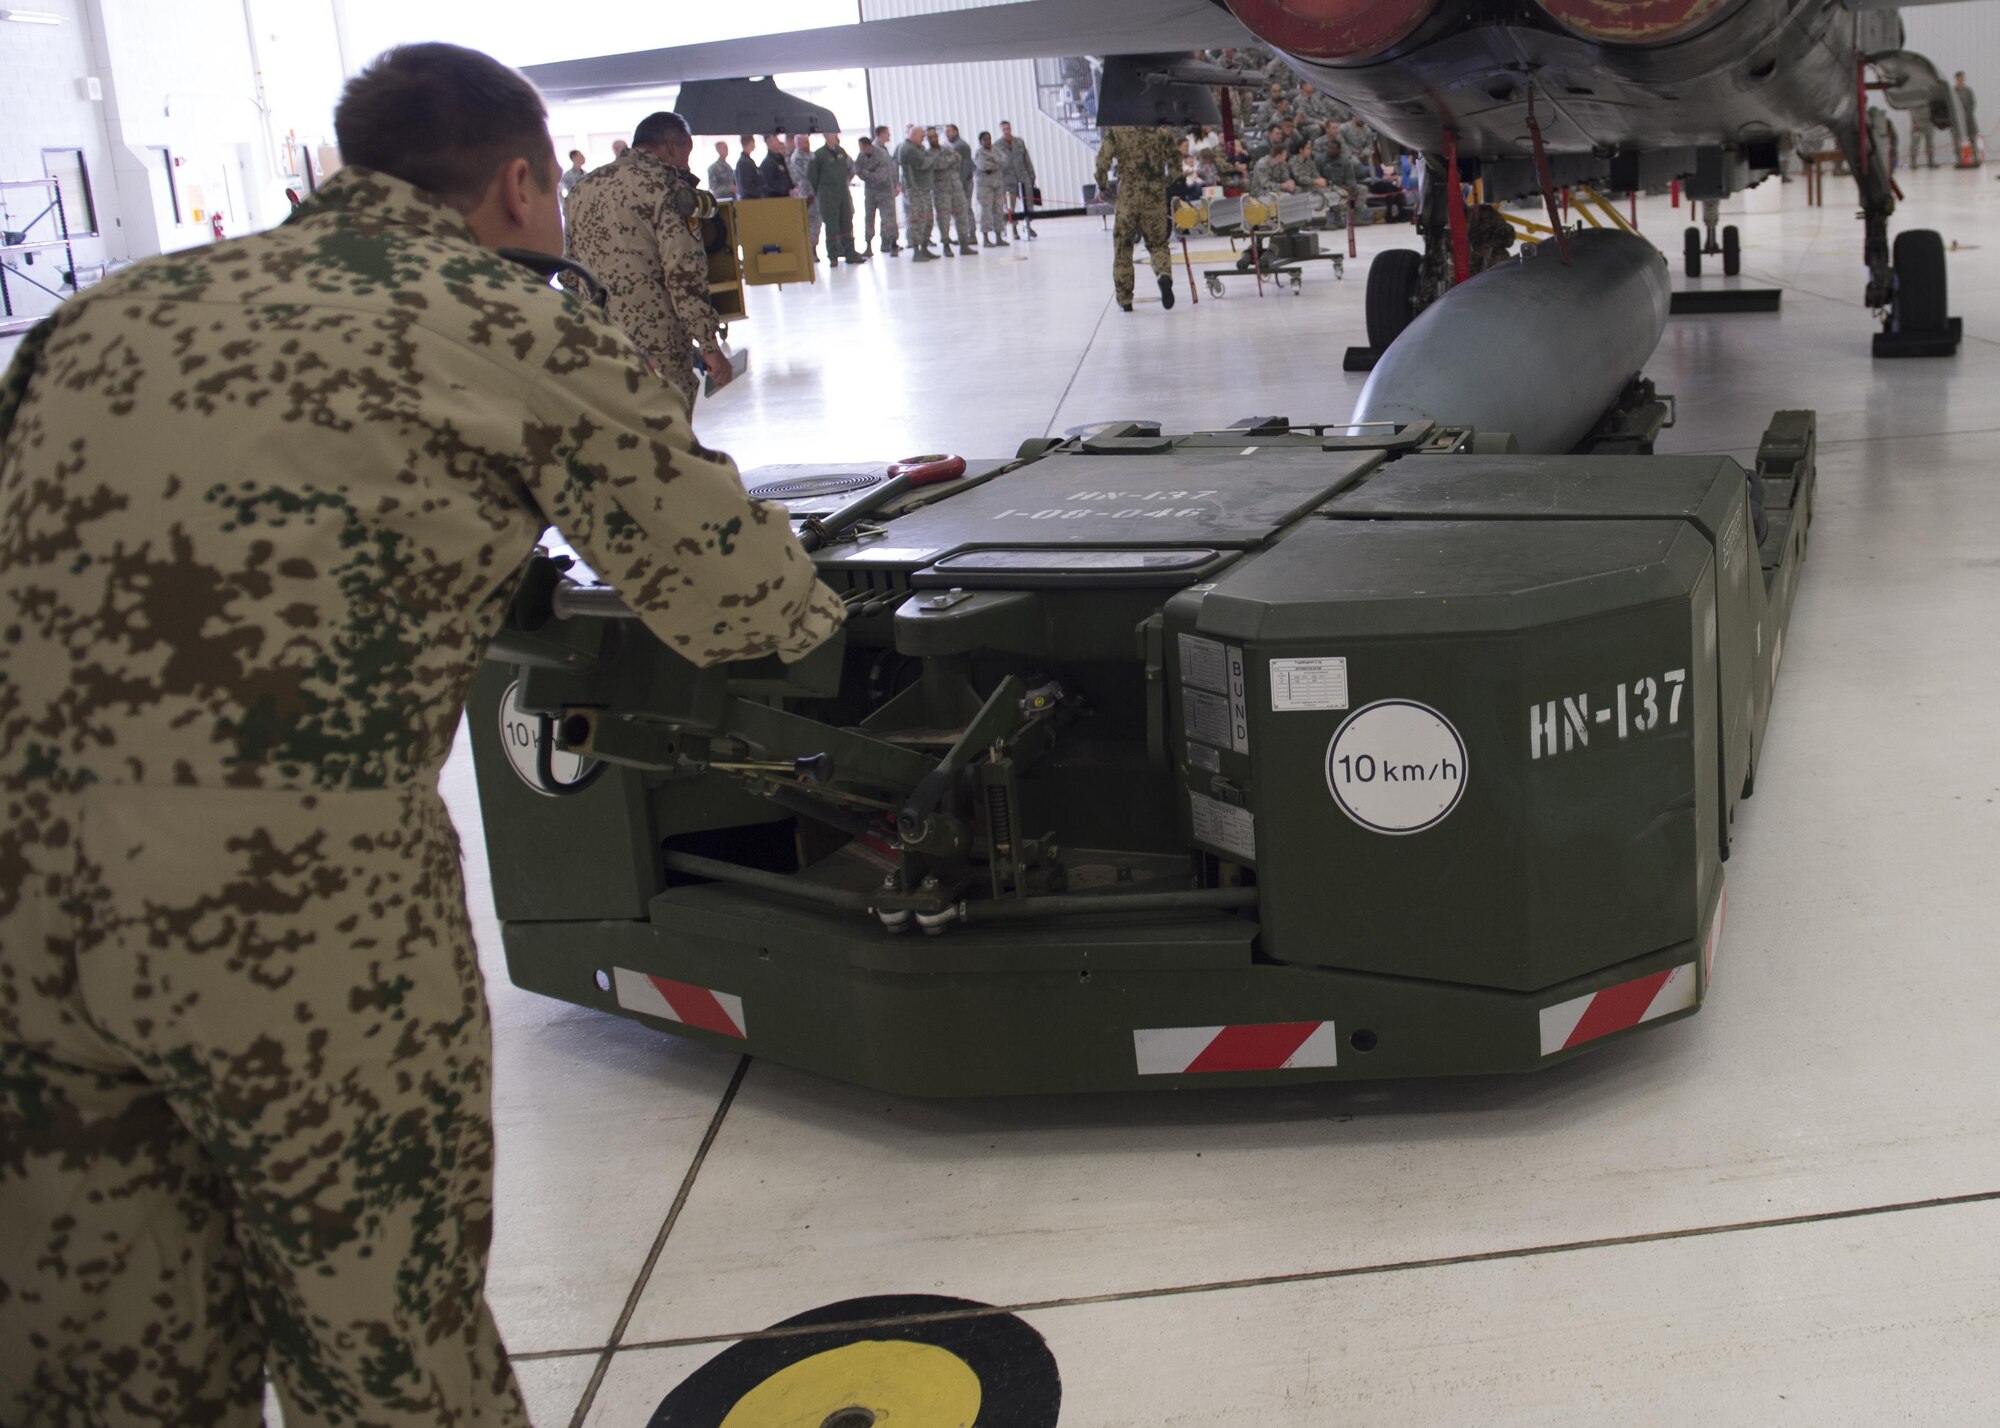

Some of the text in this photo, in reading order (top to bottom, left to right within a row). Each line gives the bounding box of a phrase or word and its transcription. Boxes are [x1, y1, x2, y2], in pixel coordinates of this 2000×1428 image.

[1066, 490, 1218, 501] HN-137
[992, 508, 1206, 520] 1-08-046
[1232, 661, 1247, 740] BUND
[1530, 668, 1686, 760] HN-137
[506, 721, 529, 747] 10
[1338, 754, 1457, 783] 10 km/h
